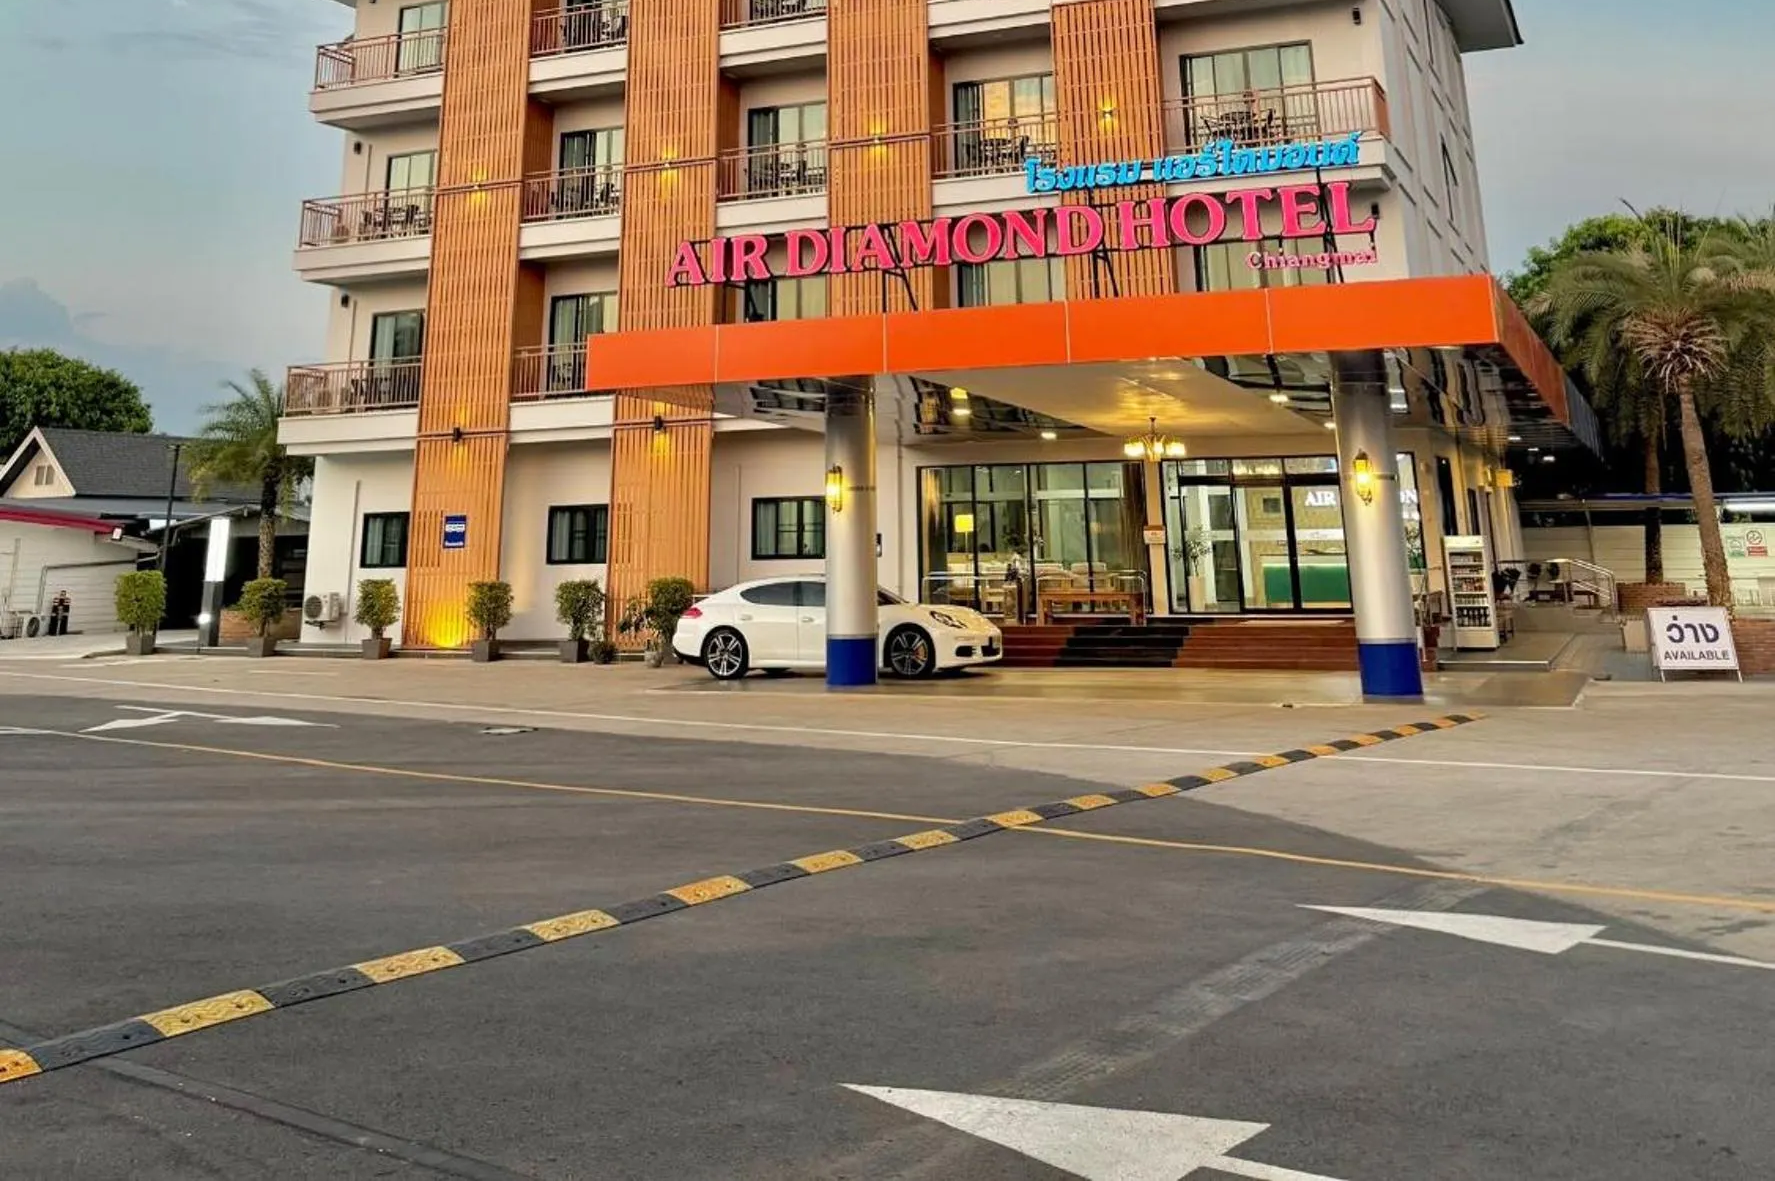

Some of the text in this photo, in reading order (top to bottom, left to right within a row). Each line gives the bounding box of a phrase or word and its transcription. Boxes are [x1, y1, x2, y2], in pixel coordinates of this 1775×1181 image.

[1024, 156, 1142, 194] โรงแรม
[664, 181, 1376, 287] AIR DIAMOND HOTEL
[1245, 249, 1377, 269] Chiangmai
[1305, 490, 1337, 507] AIR
[1666, 615, 1719, 643] ว่าง
[1664, 650, 1730, 660] AVAILABLE
